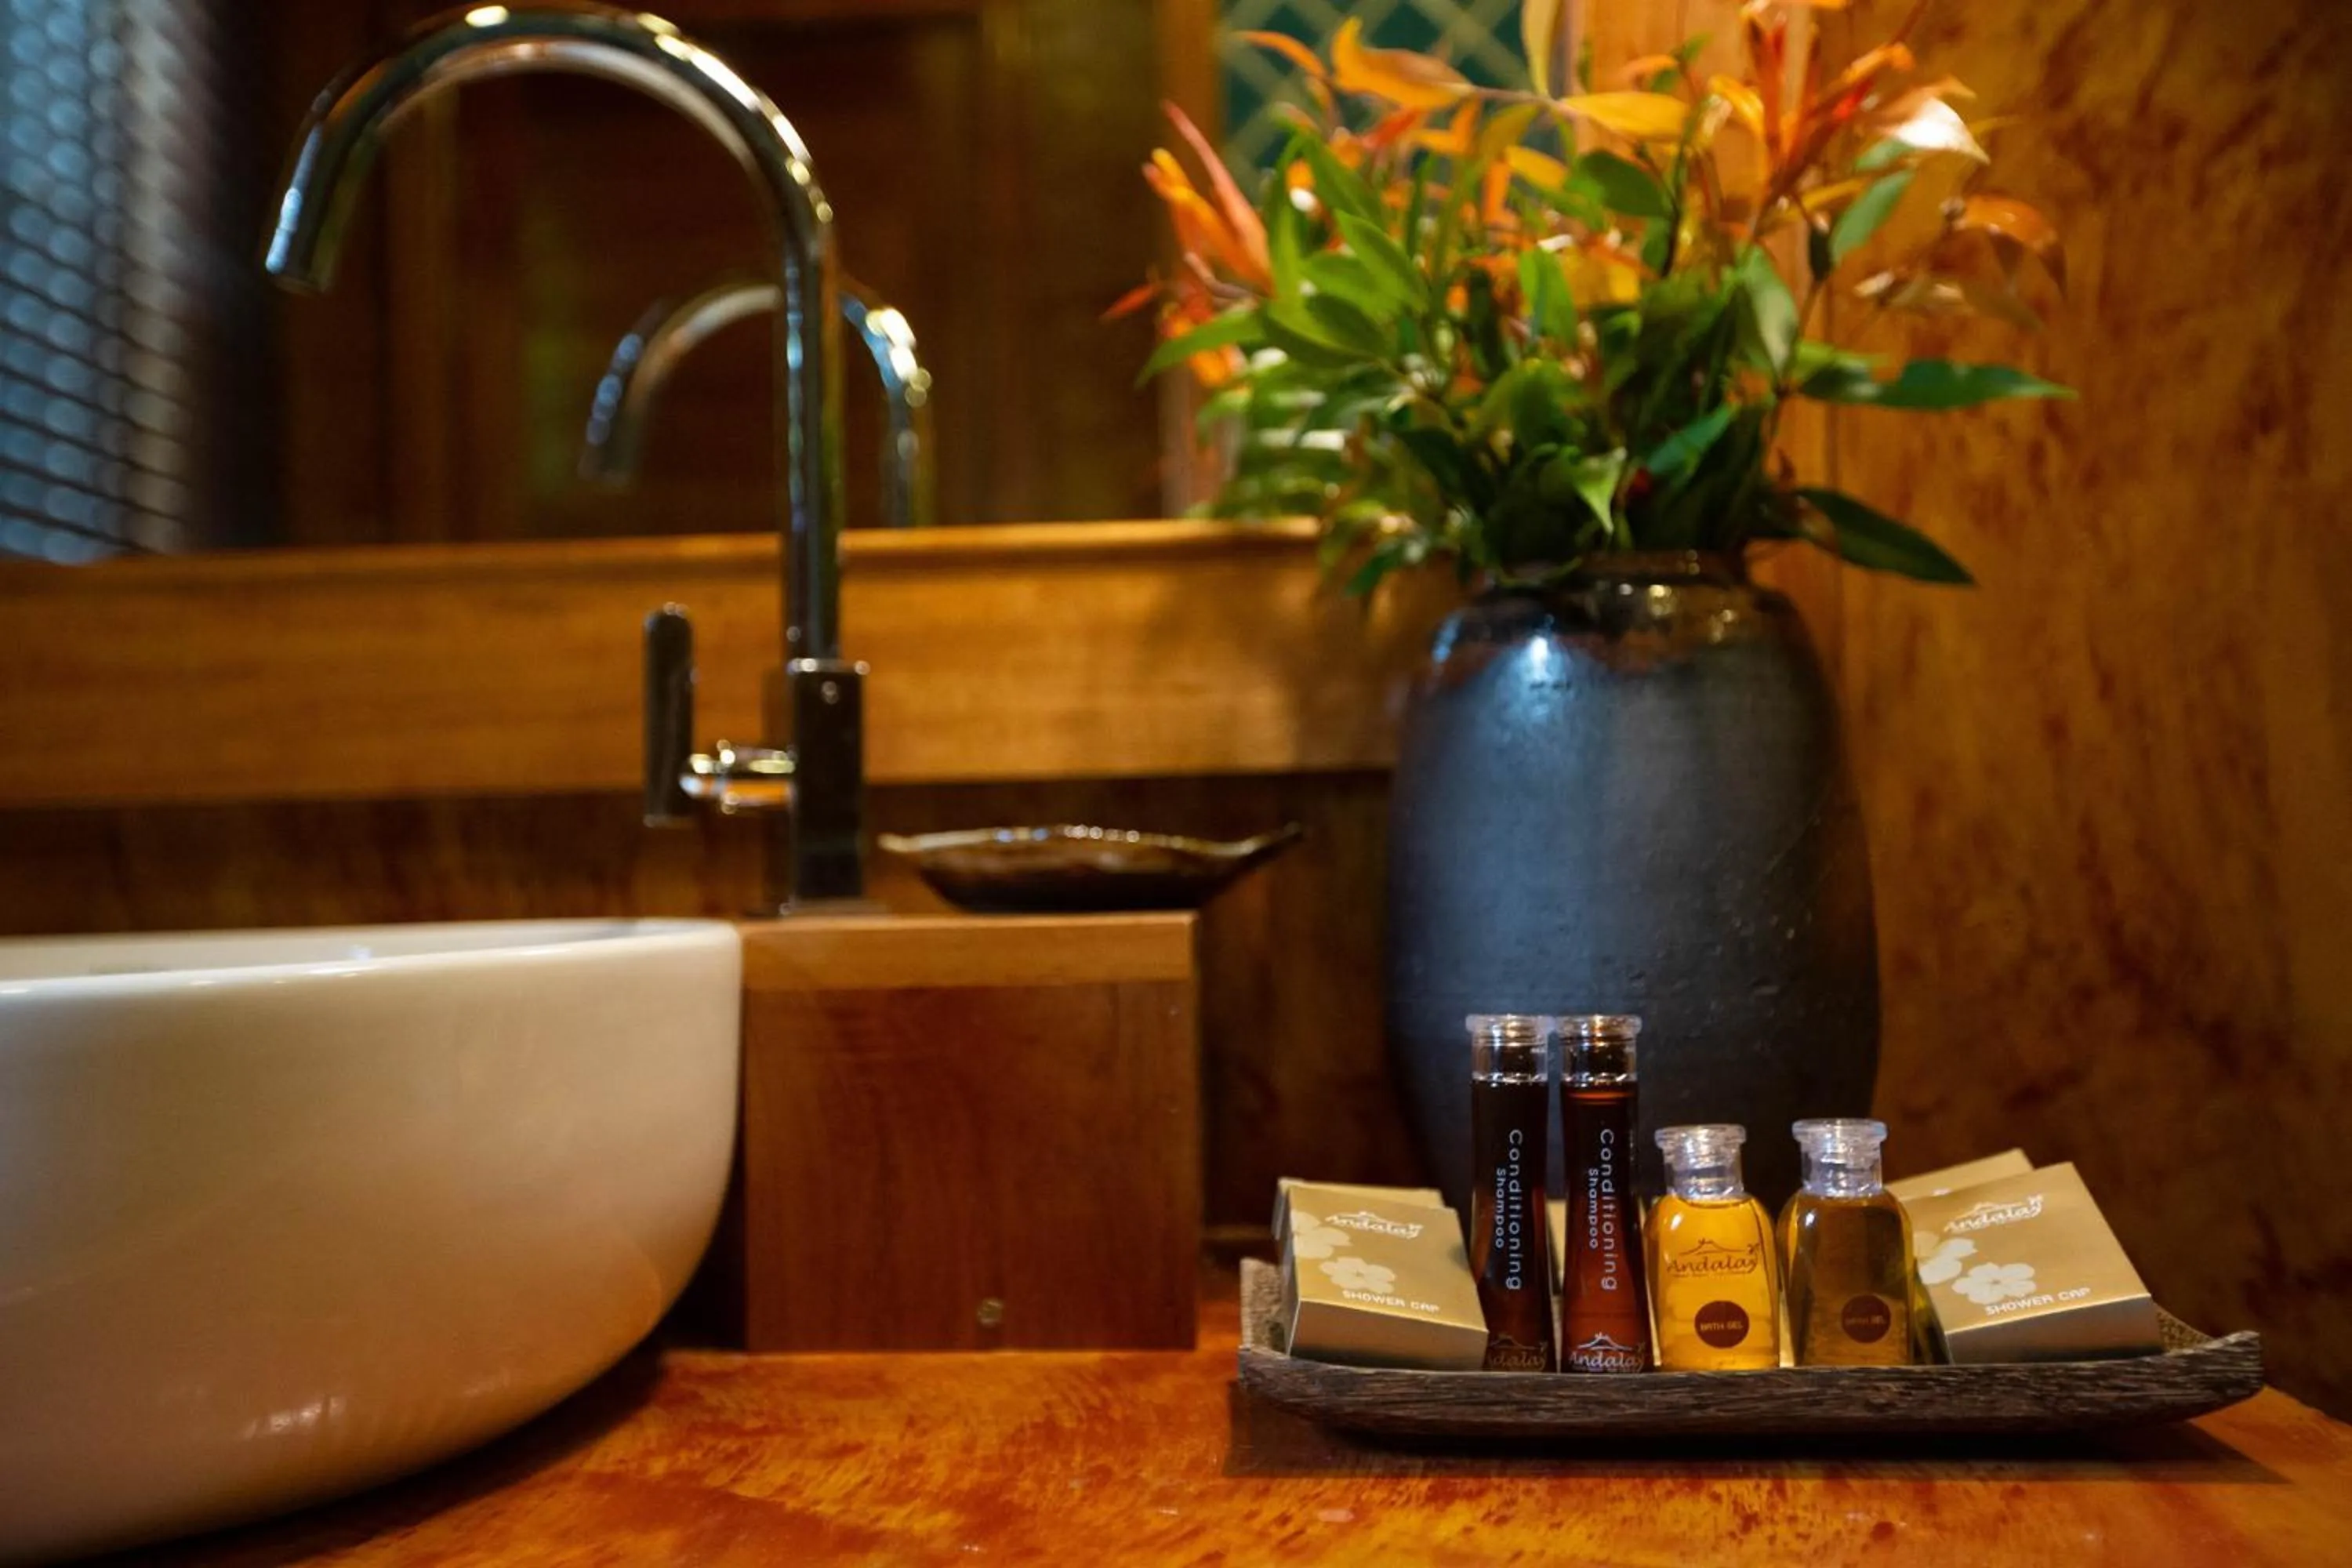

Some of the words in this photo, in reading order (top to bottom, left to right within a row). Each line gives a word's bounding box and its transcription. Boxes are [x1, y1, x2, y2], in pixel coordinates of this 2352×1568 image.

[1494, 1168, 1506, 1249] Shampoo
[1505, 1129, 1523, 1290] Conditioning
[1588, 1168, 1599, 1249] Shampoo
[1600, 1128, 1618, 1290] Conditioning
[1341, 1290, 1406, 1308] SHOWER
[1410, 1301, 1441, 1314] CAP
[1699, 1322, 1725, 1331] BATH
[1726, 1319, 1744, 1330] GEL
[1984, 1294, 2054, 1316] SHOWER
[2057, 1287, 2092, 1301] CAP
